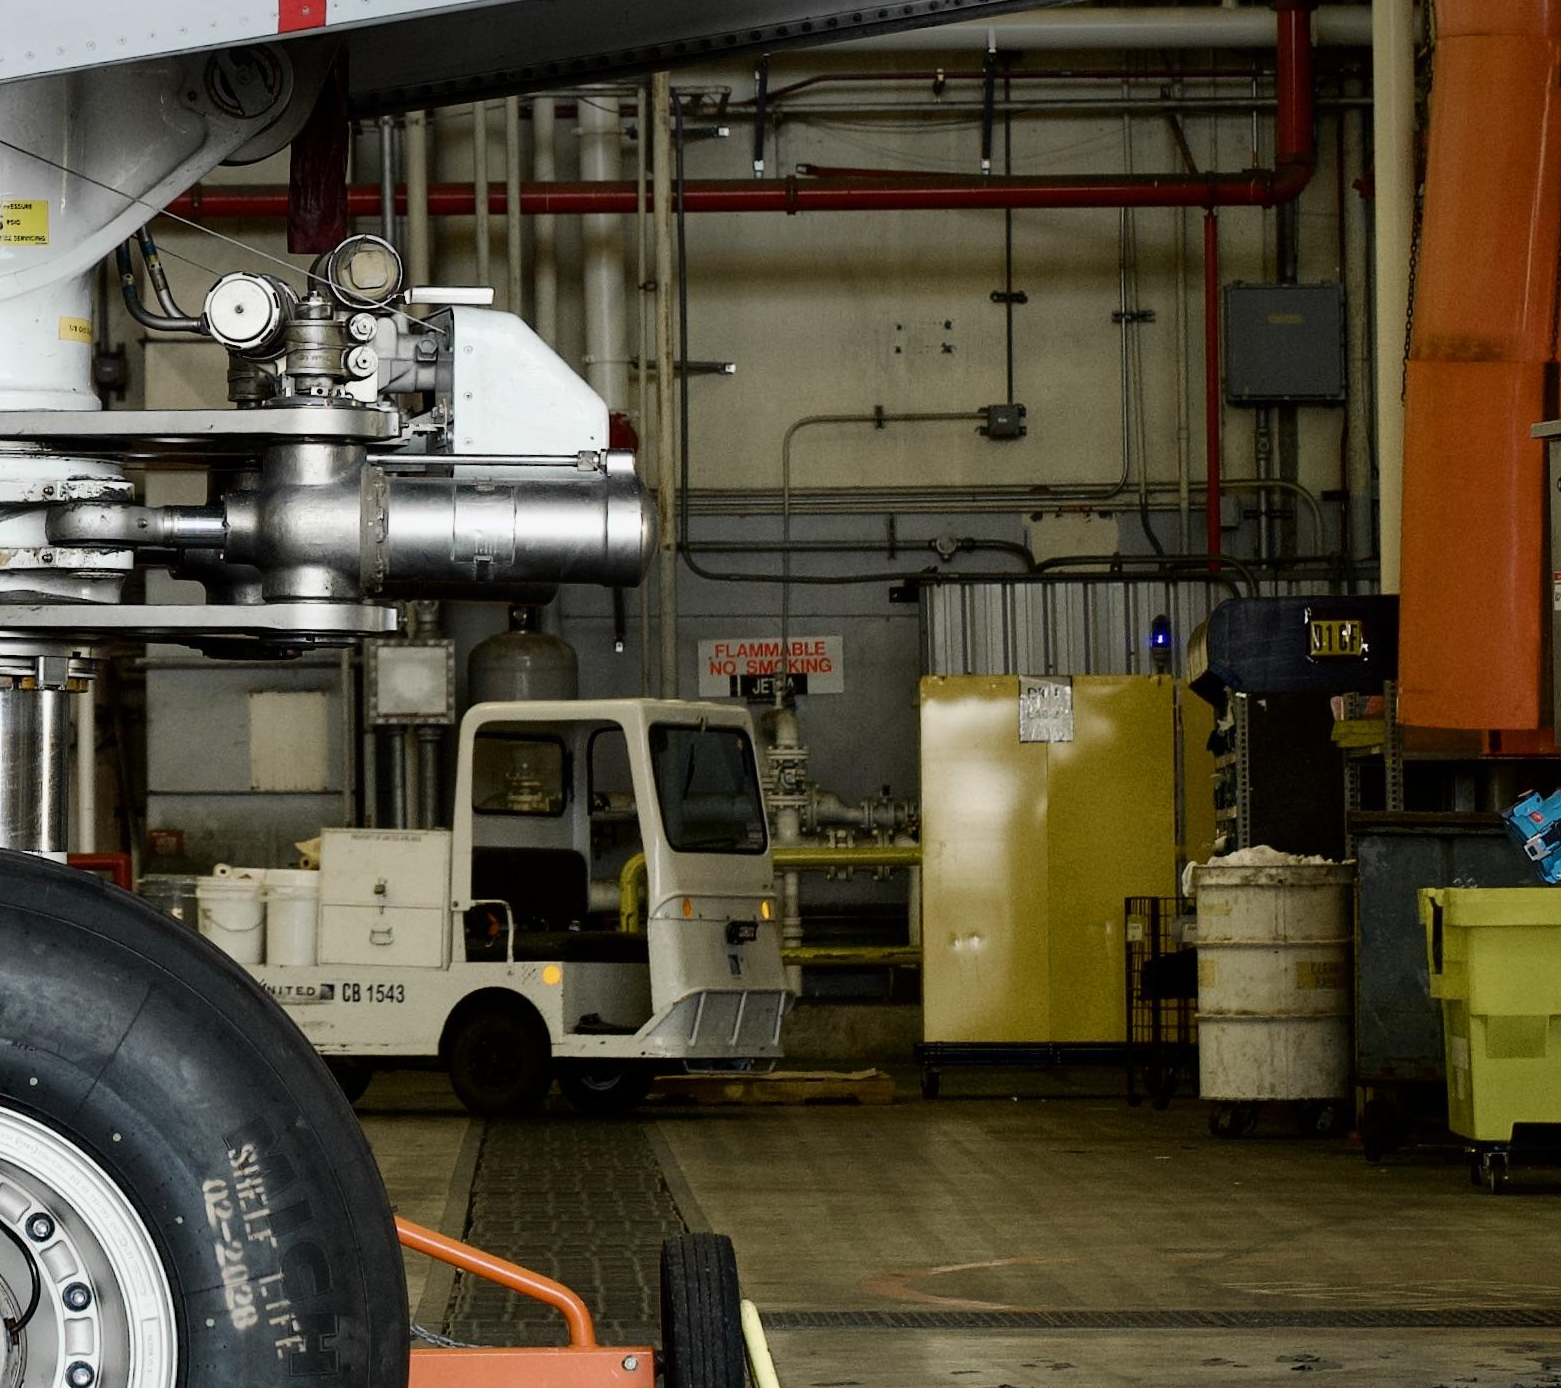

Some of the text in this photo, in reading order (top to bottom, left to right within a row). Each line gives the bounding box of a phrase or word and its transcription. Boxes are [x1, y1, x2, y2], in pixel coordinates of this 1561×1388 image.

[714, 641, 826, 659] FLAMMABLE
[709, 657, 833, 676] NO SMOKING
[266, 985, 316, 997] NITED
[341, 982, 406, 1004] CB 1543
[227, 1142, 308, 1360] SHELF LIFE
